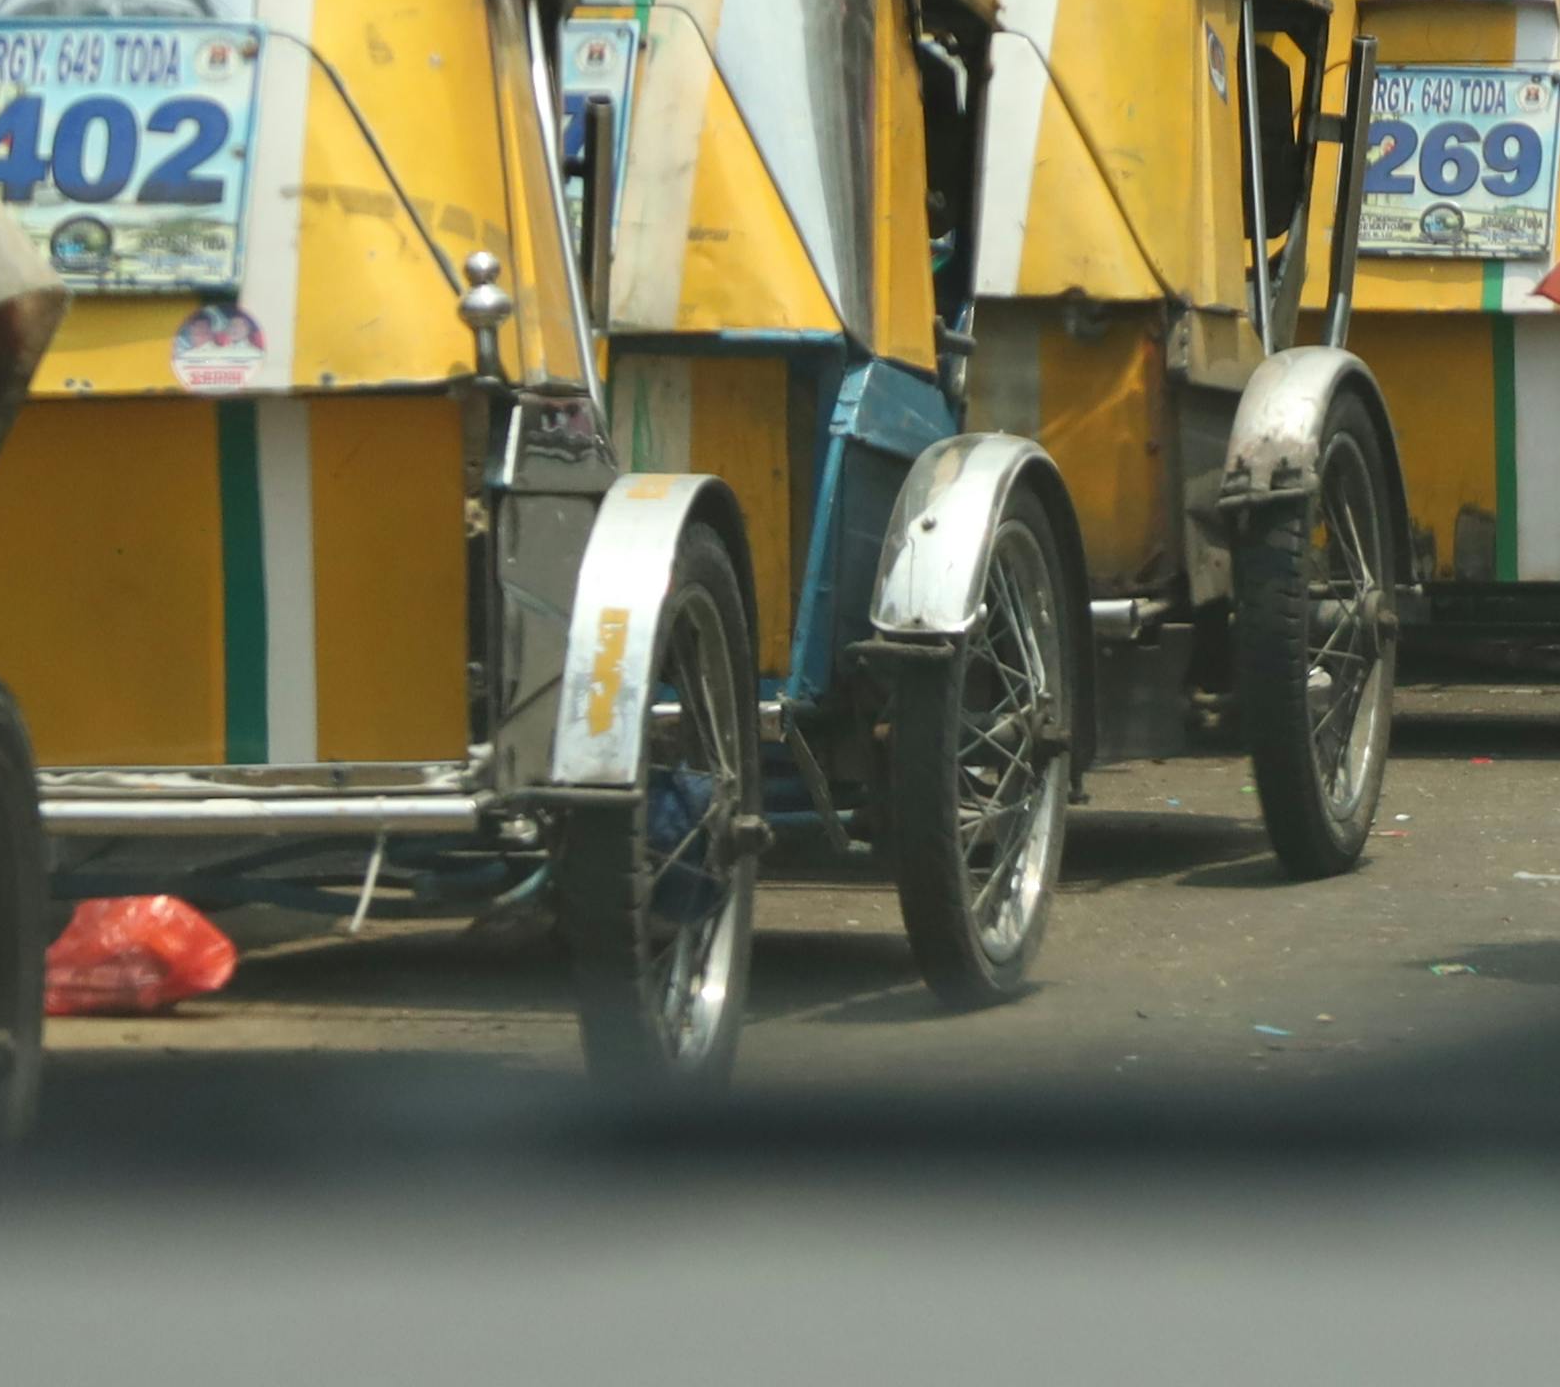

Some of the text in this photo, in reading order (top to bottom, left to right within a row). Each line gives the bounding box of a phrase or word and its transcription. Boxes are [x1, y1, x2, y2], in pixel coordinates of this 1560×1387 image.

[57, 35, 105, 84] 649
[115, 36, 183, 84] TODA
[1371, 78, 1507, 114] RGY. 649 TODA
[1363, 119, 1543, 197] 269
